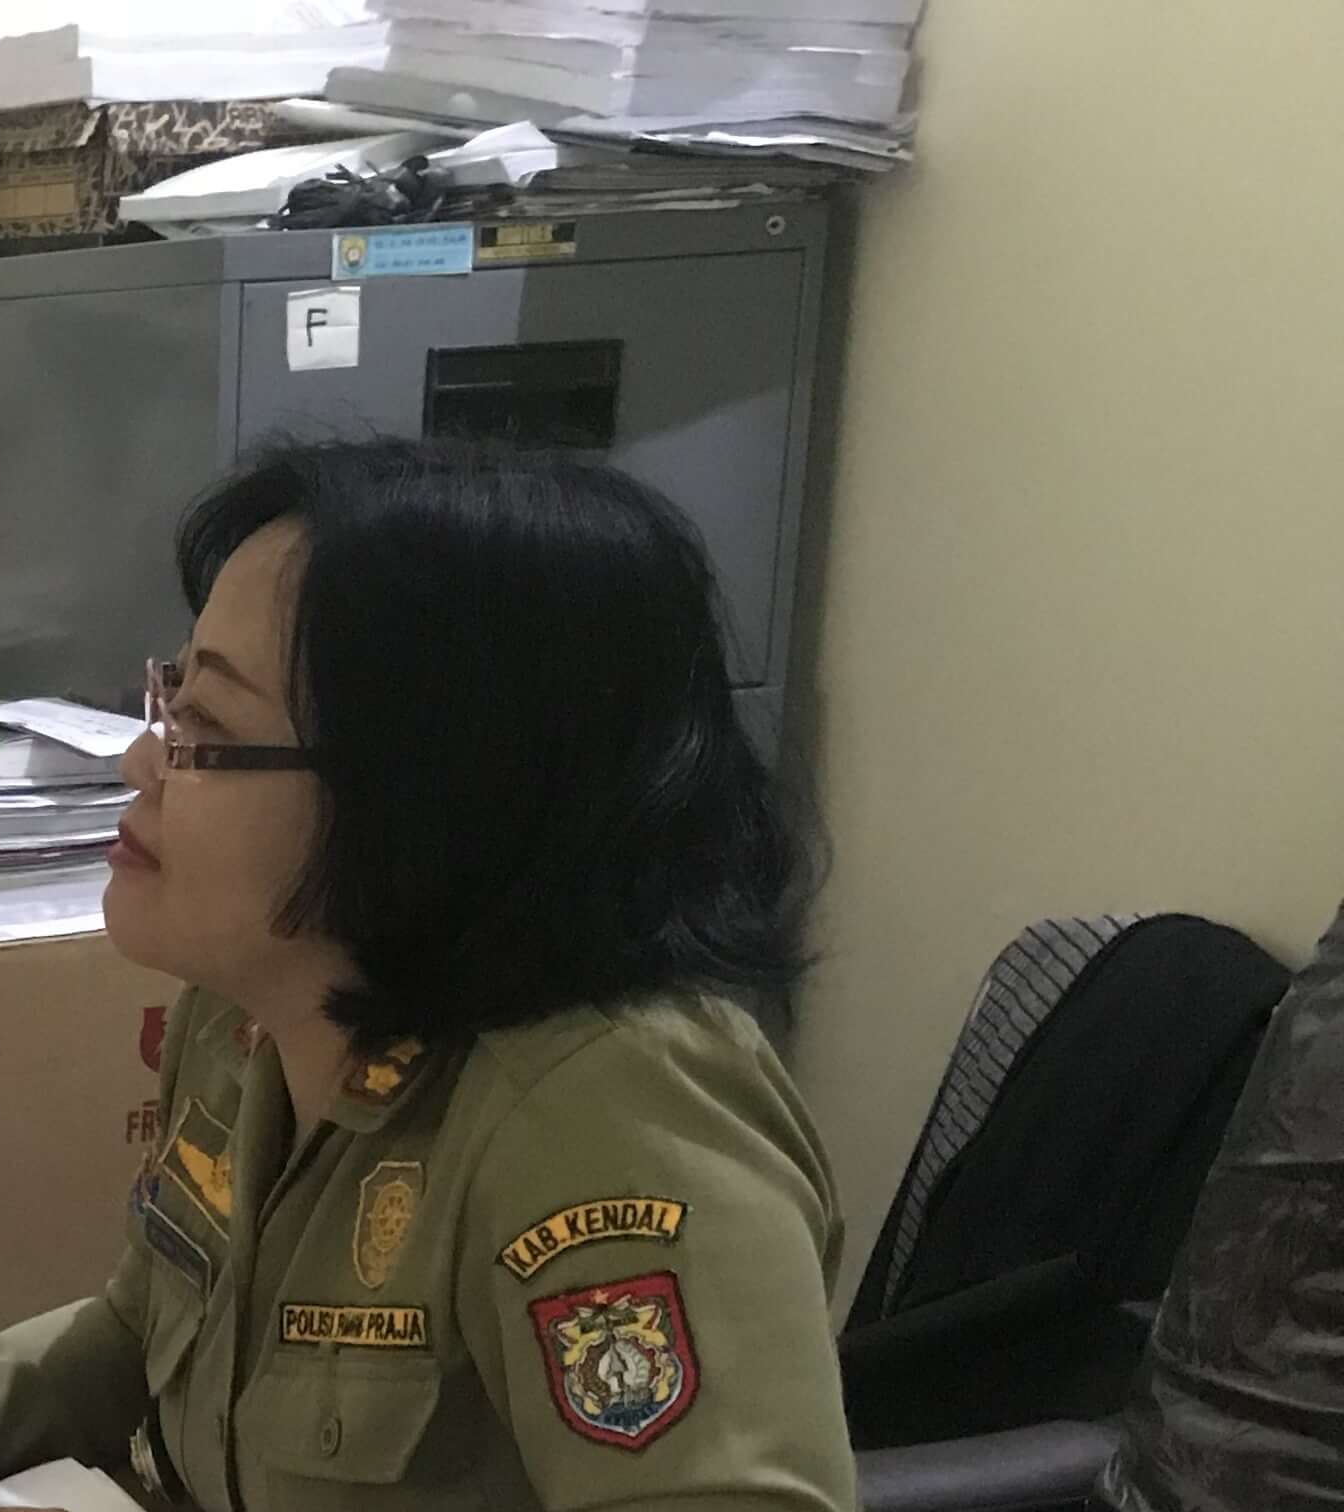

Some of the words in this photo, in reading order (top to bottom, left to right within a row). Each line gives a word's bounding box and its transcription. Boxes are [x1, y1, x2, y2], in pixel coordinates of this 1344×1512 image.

[305, 308, 327, 347] F
[565, 1202, 672, 1243] KENDAL
[286, 1309, 335, 1337] POLISI
[365, 1311, 423, 1341] PRAJA
